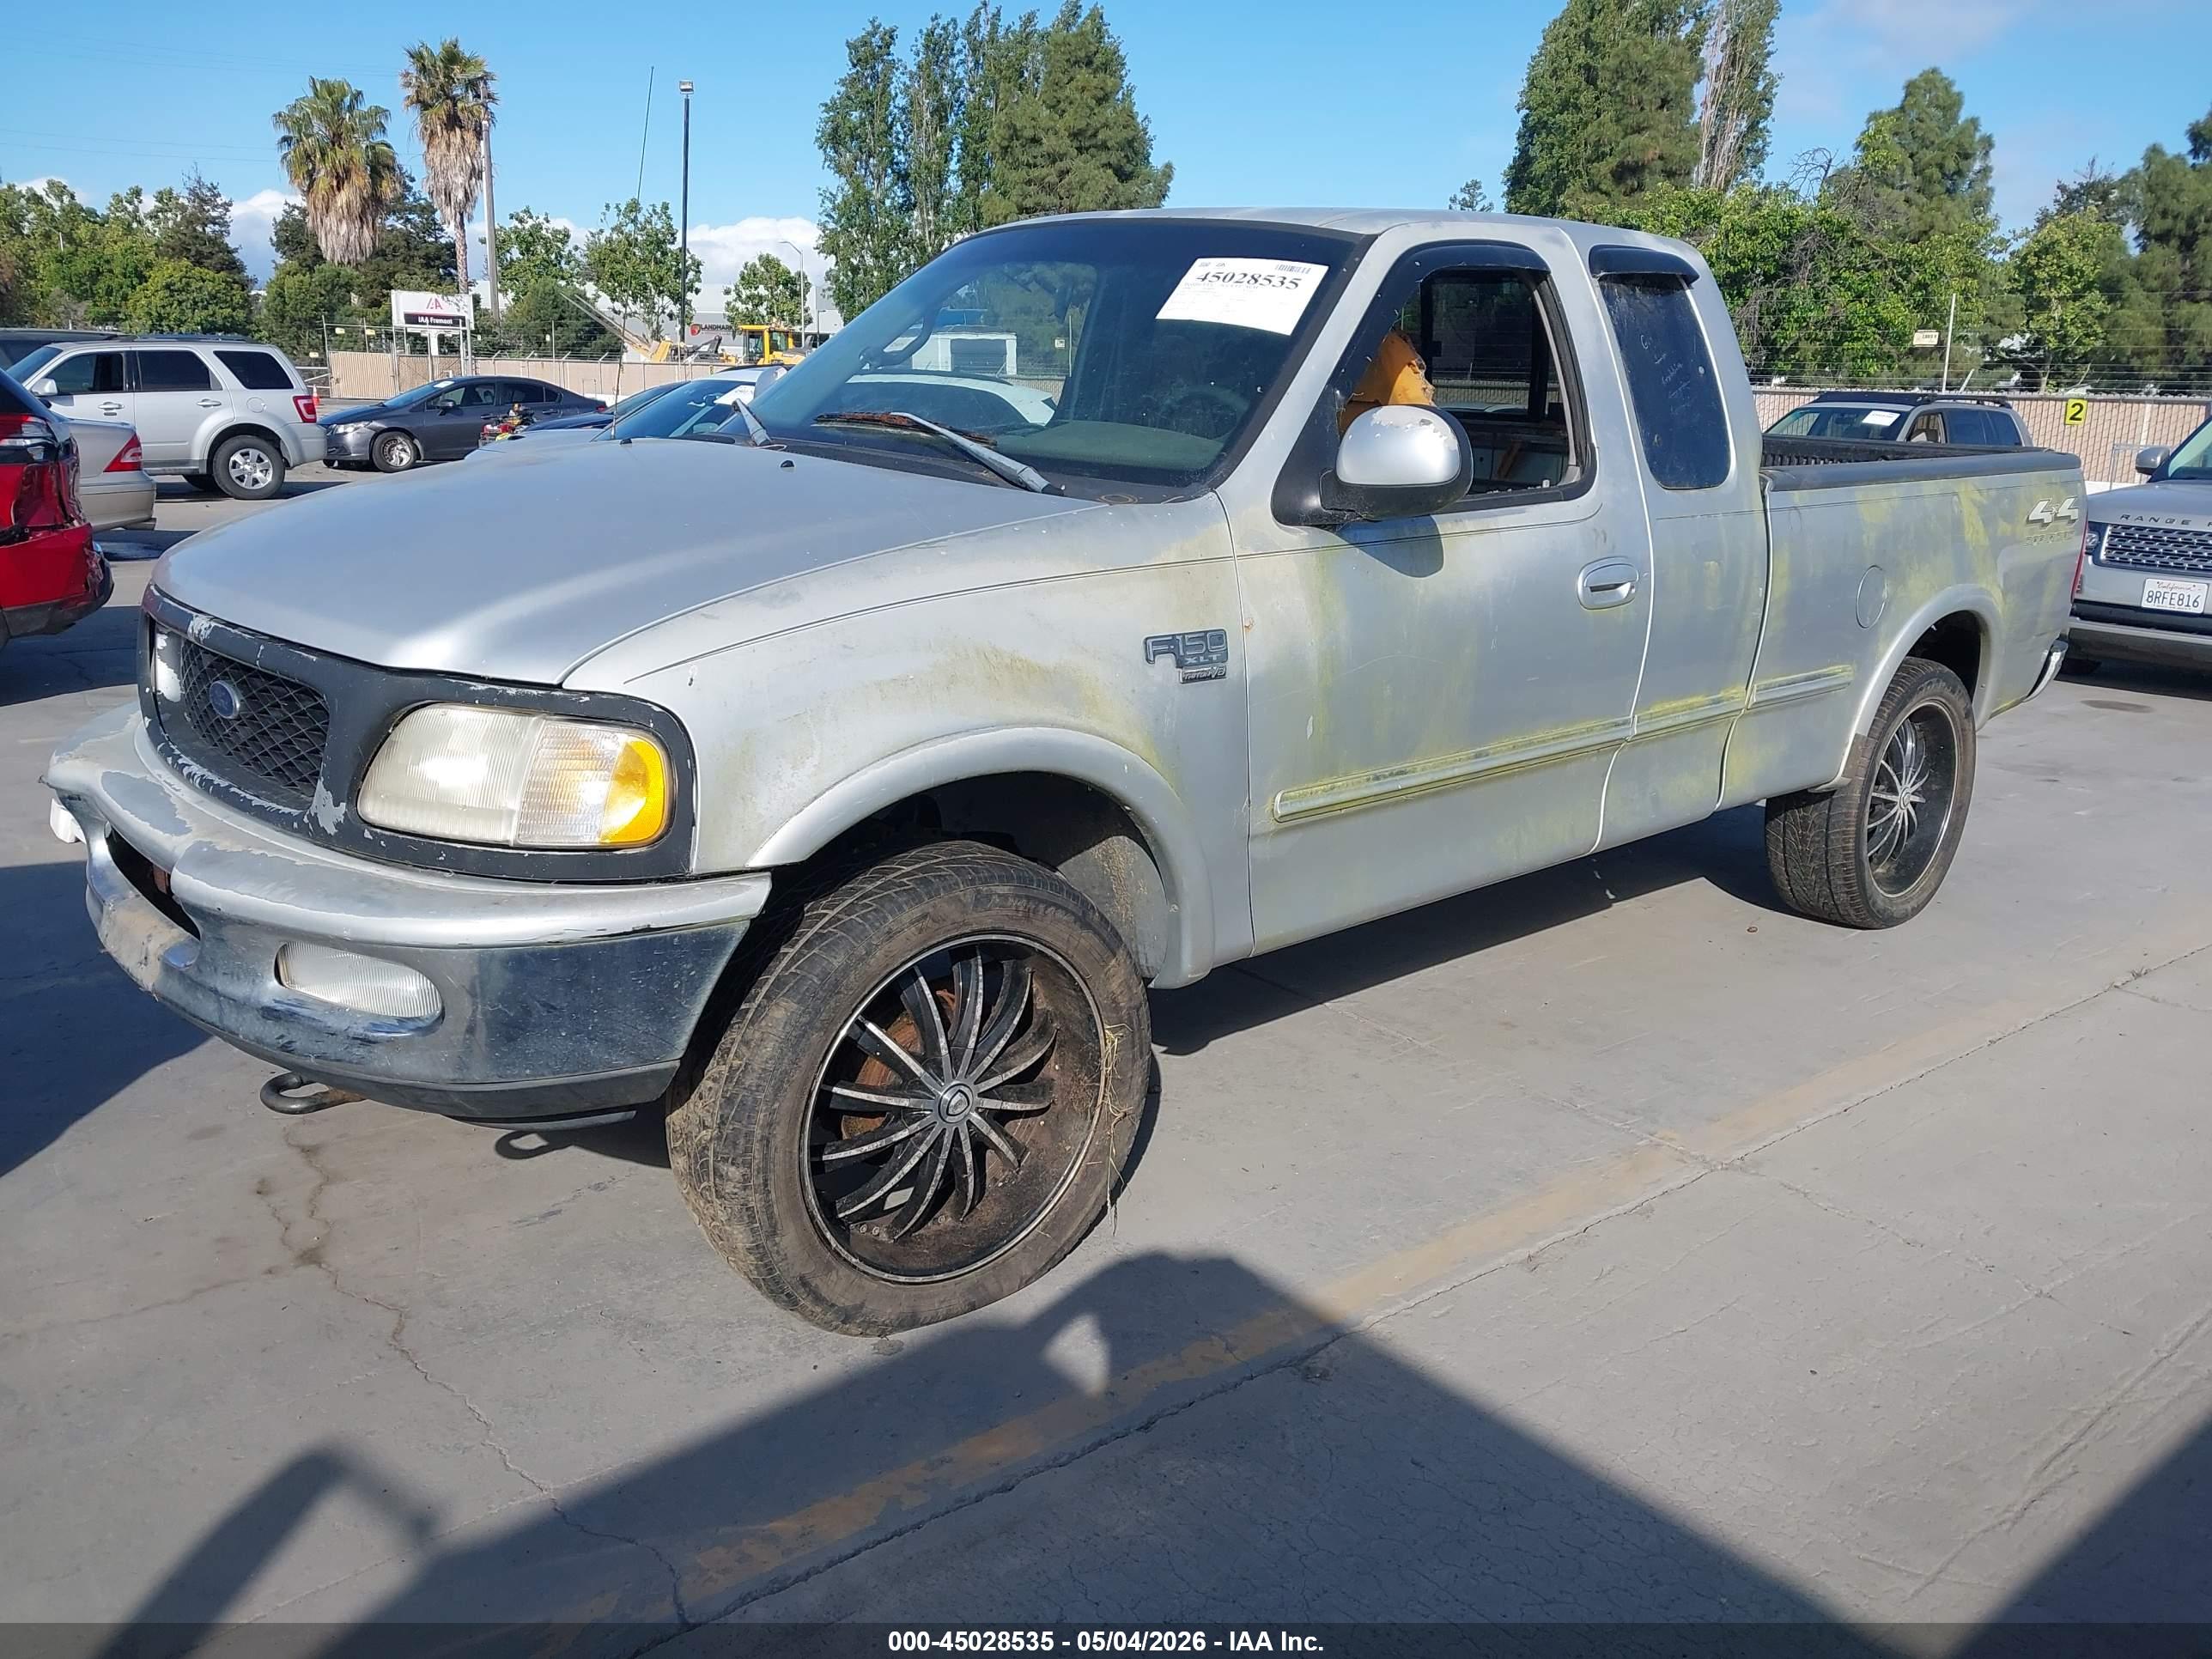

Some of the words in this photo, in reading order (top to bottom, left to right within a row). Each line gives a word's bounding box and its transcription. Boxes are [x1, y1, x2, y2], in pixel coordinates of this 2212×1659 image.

[1195, 271, 1302, 290] 45028535
[2069, 402, 2084, 422] 2
[2120, 514, 2192, 526] RANGE
[2147, 590, 2201, 608] 8RFE816
[1186, 653, 1222, 664] XLT
